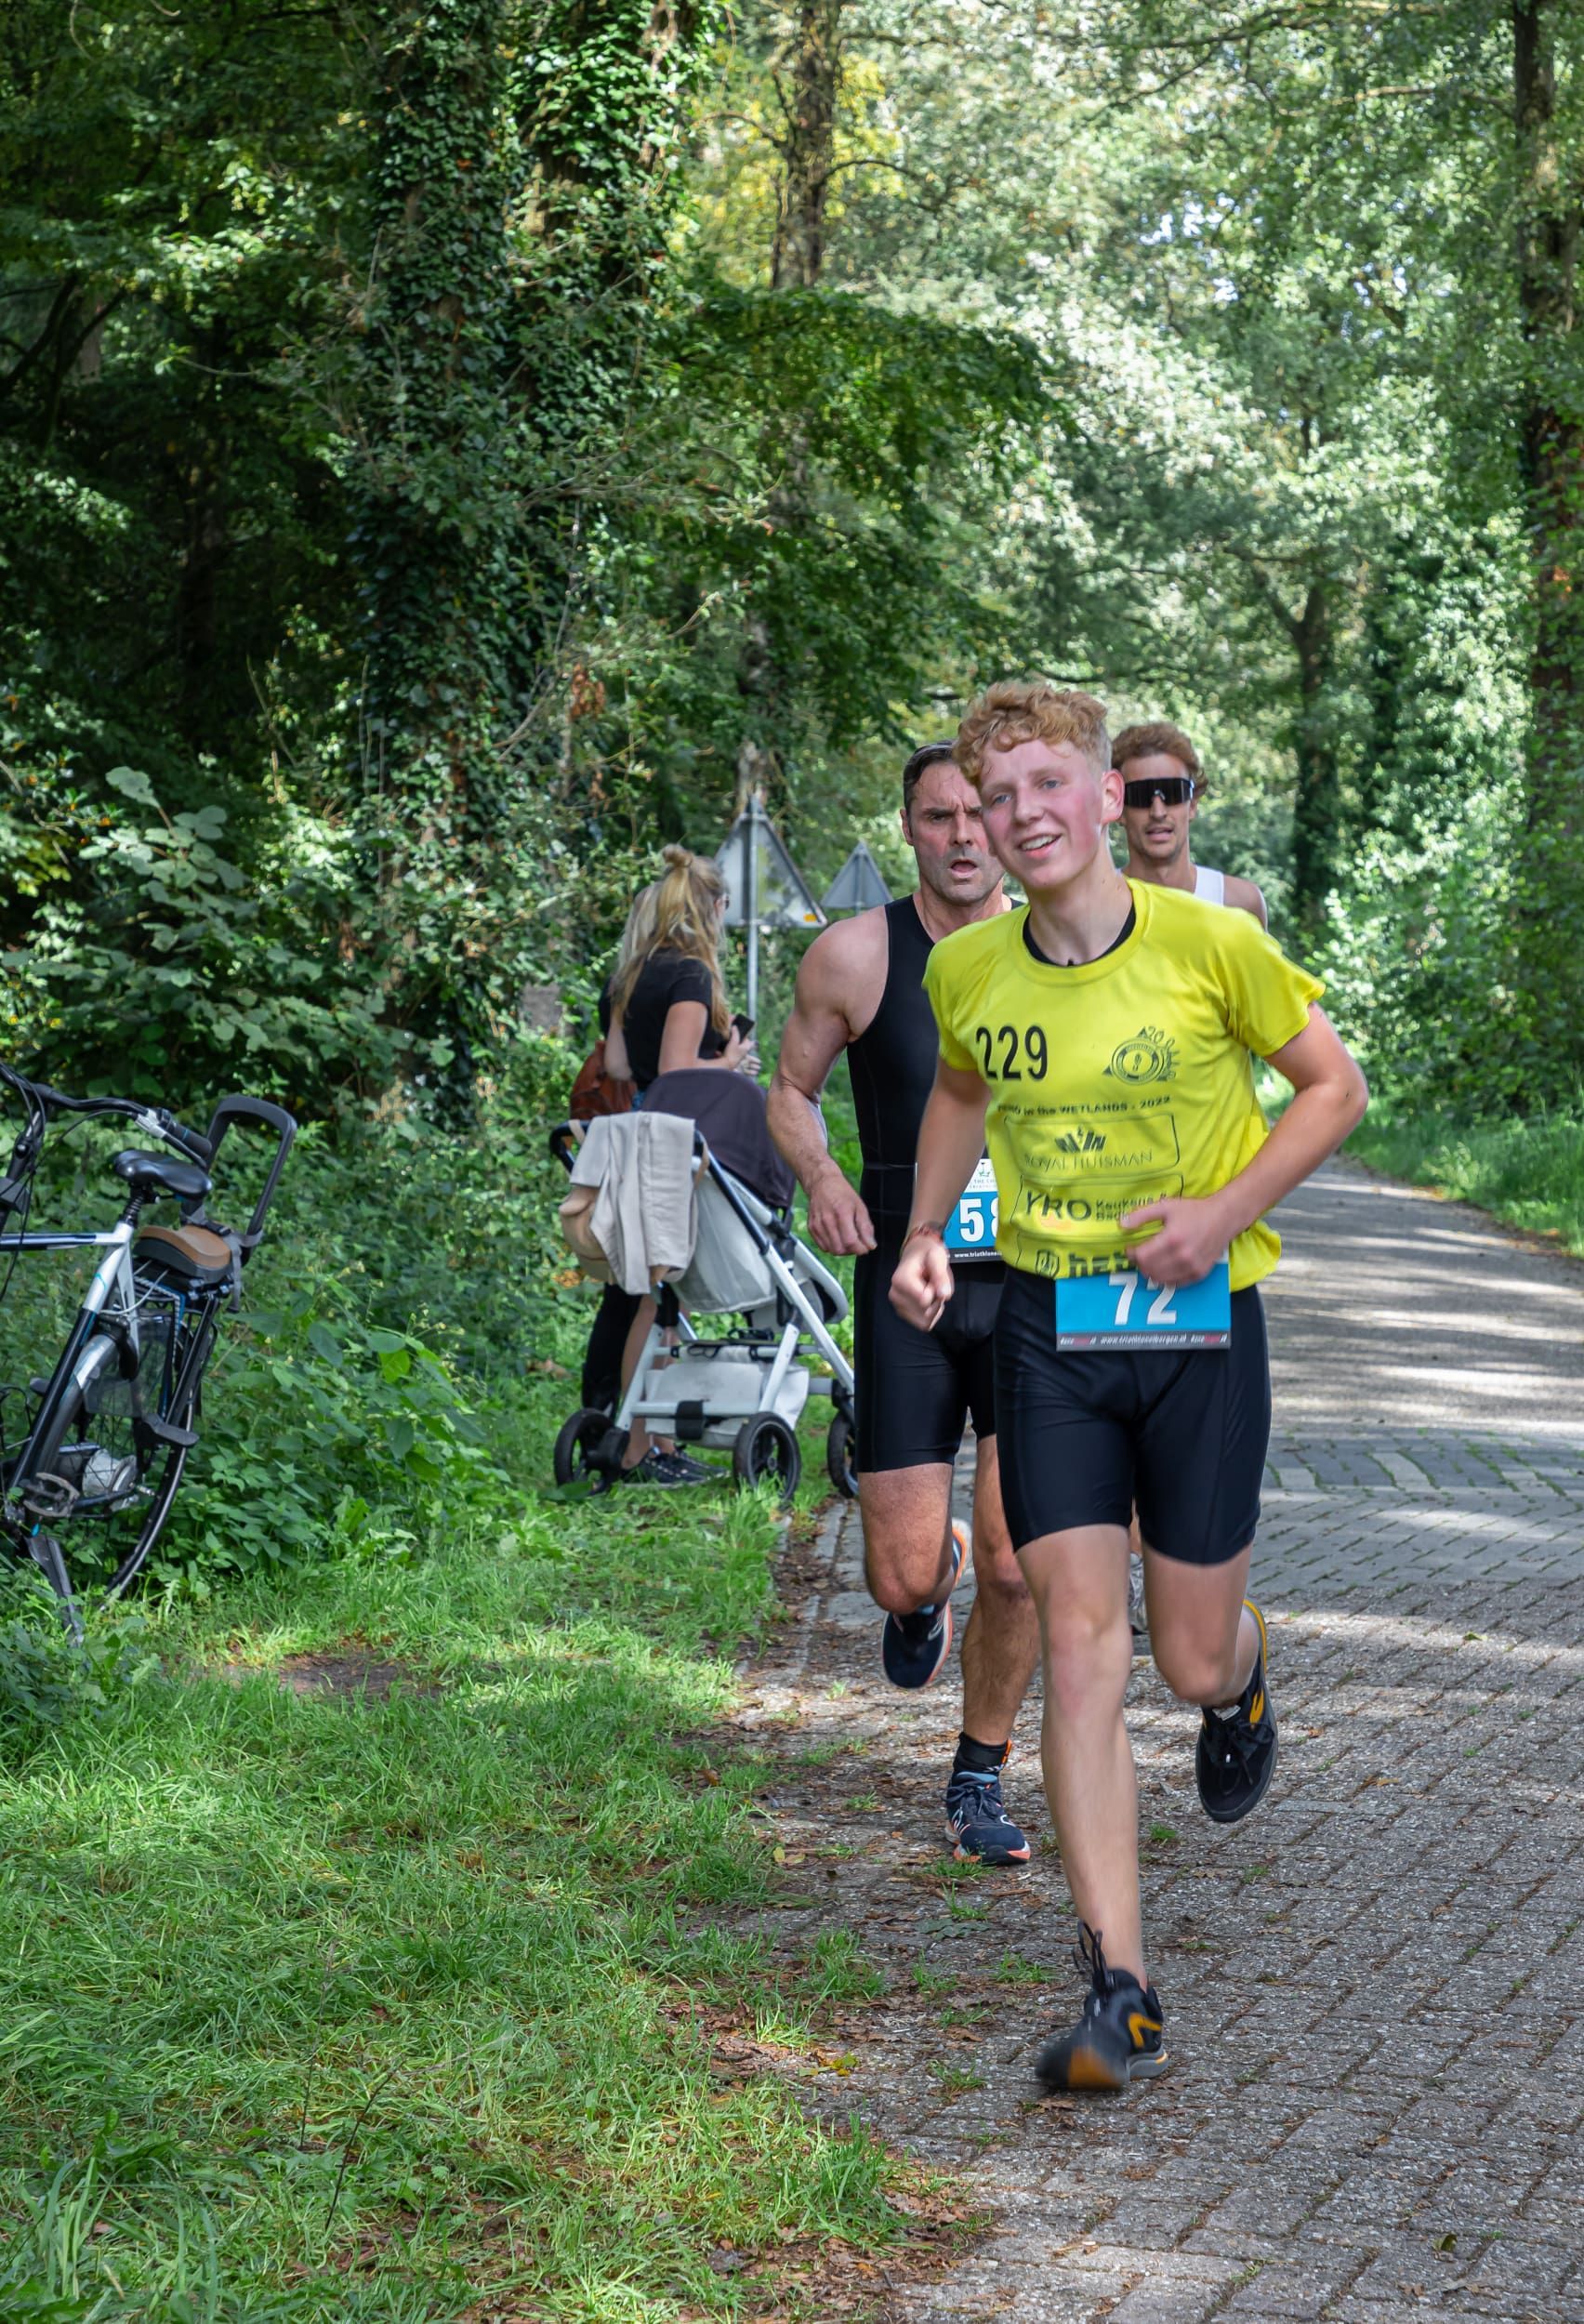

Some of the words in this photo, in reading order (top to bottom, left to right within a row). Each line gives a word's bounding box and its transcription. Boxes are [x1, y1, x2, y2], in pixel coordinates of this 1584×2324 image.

[976, 1025, 1048, 1081] 229
[1059, 1103, 1128, 1114] WETLANDS
[1139, 1094, 1172, 1109] 2022
[1074, 1148, 1153, 1169] HUISMAN
[1026, 1190, 1092, 1221] YRO
[1108, 1271, 1177, 1326] 72
